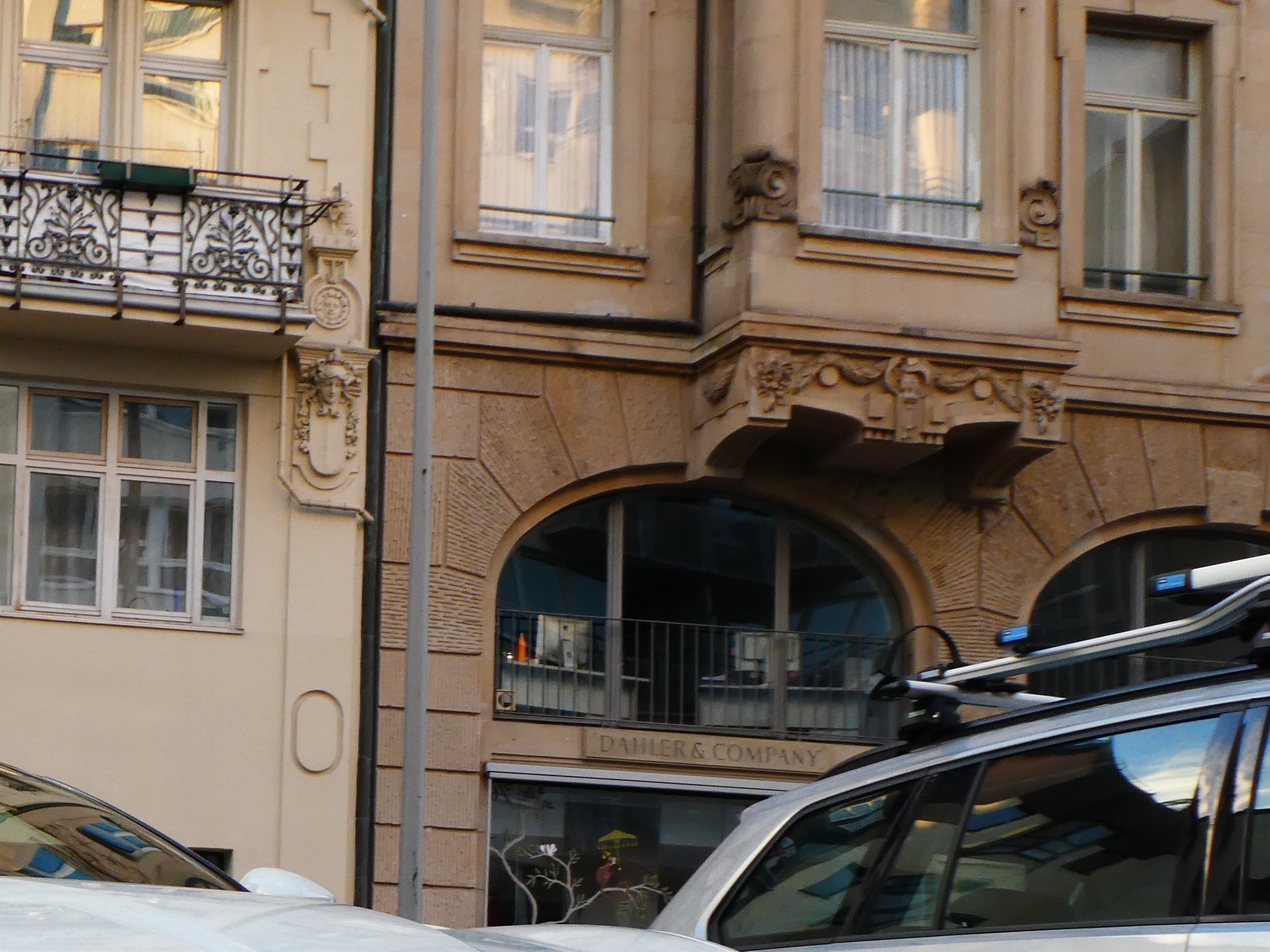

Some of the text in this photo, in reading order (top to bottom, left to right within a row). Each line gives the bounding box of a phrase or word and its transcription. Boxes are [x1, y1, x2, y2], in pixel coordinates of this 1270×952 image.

[599, 734, 822, 767] DAHLER & COMPANY
